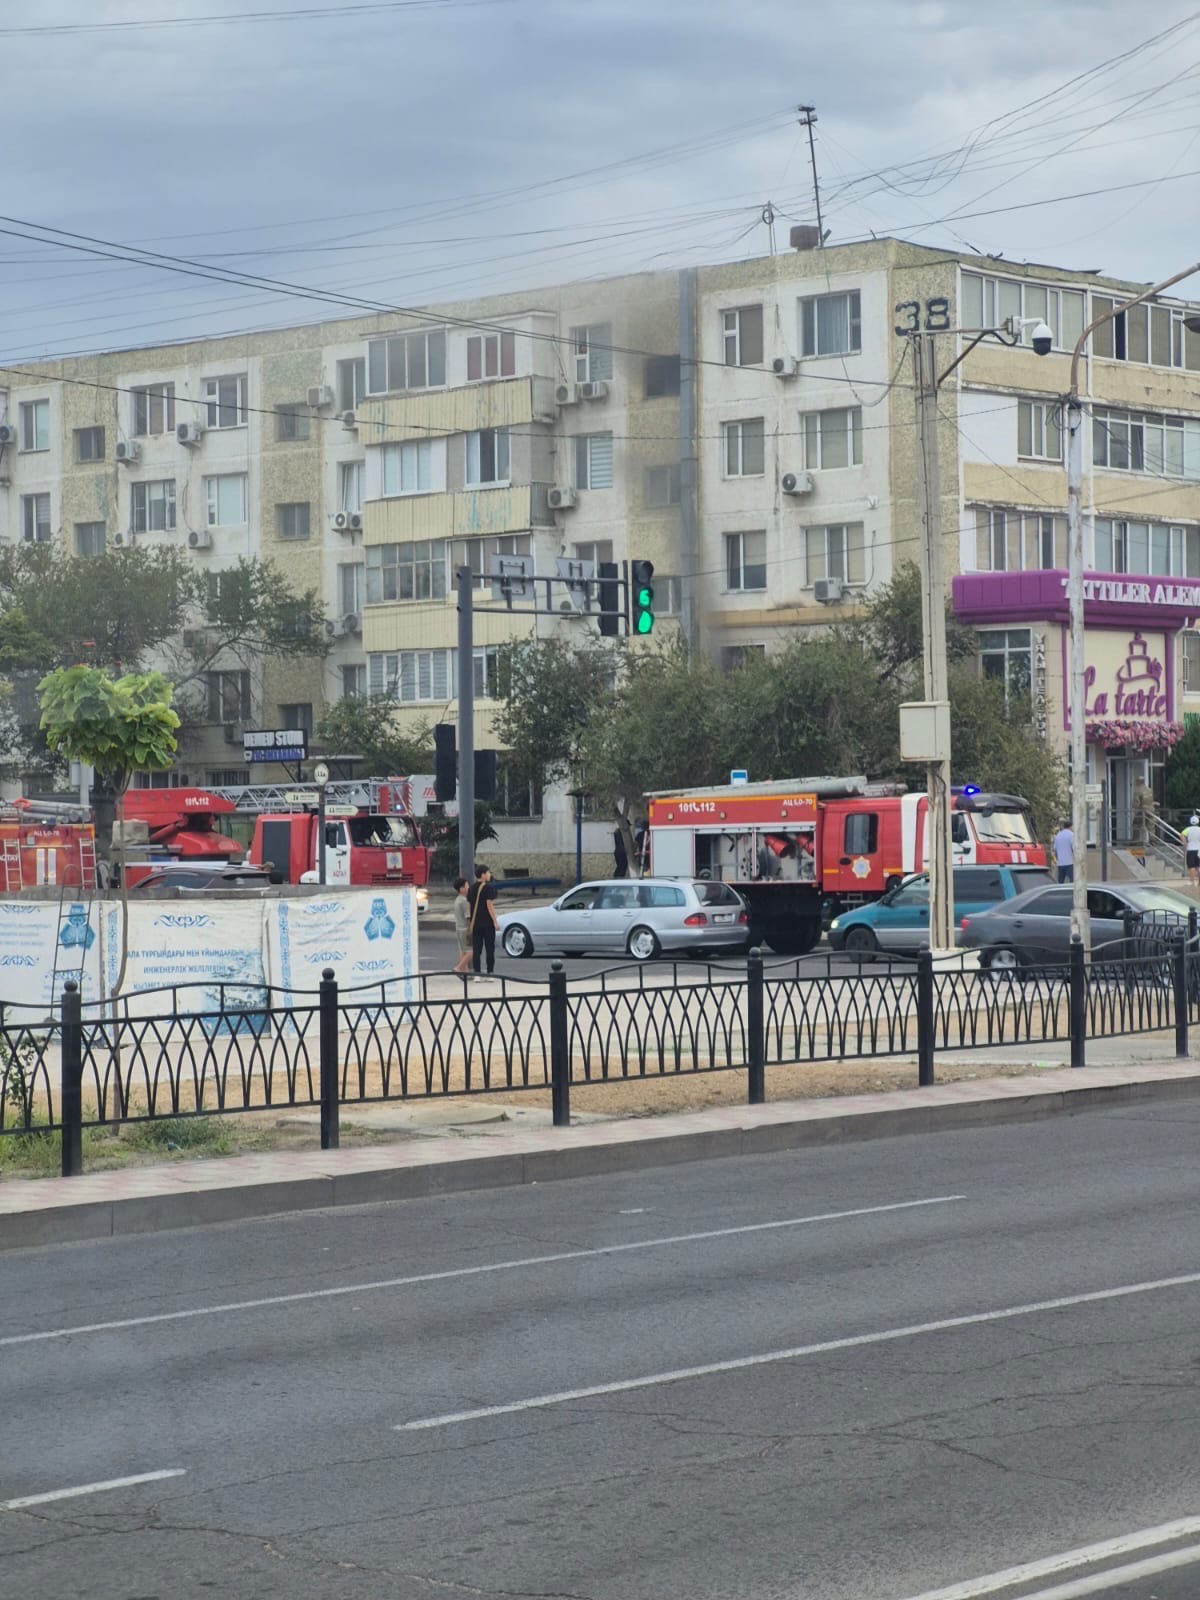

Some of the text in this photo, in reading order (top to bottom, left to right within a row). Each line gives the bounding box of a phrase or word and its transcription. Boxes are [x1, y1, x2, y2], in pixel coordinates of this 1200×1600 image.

[895, 300, 948, 336] 38
[1061, 578, 1152, 604] TTTILER
[1115, 682, 1167, 717] tarte
[678, 802, 716, 813] 101 112
